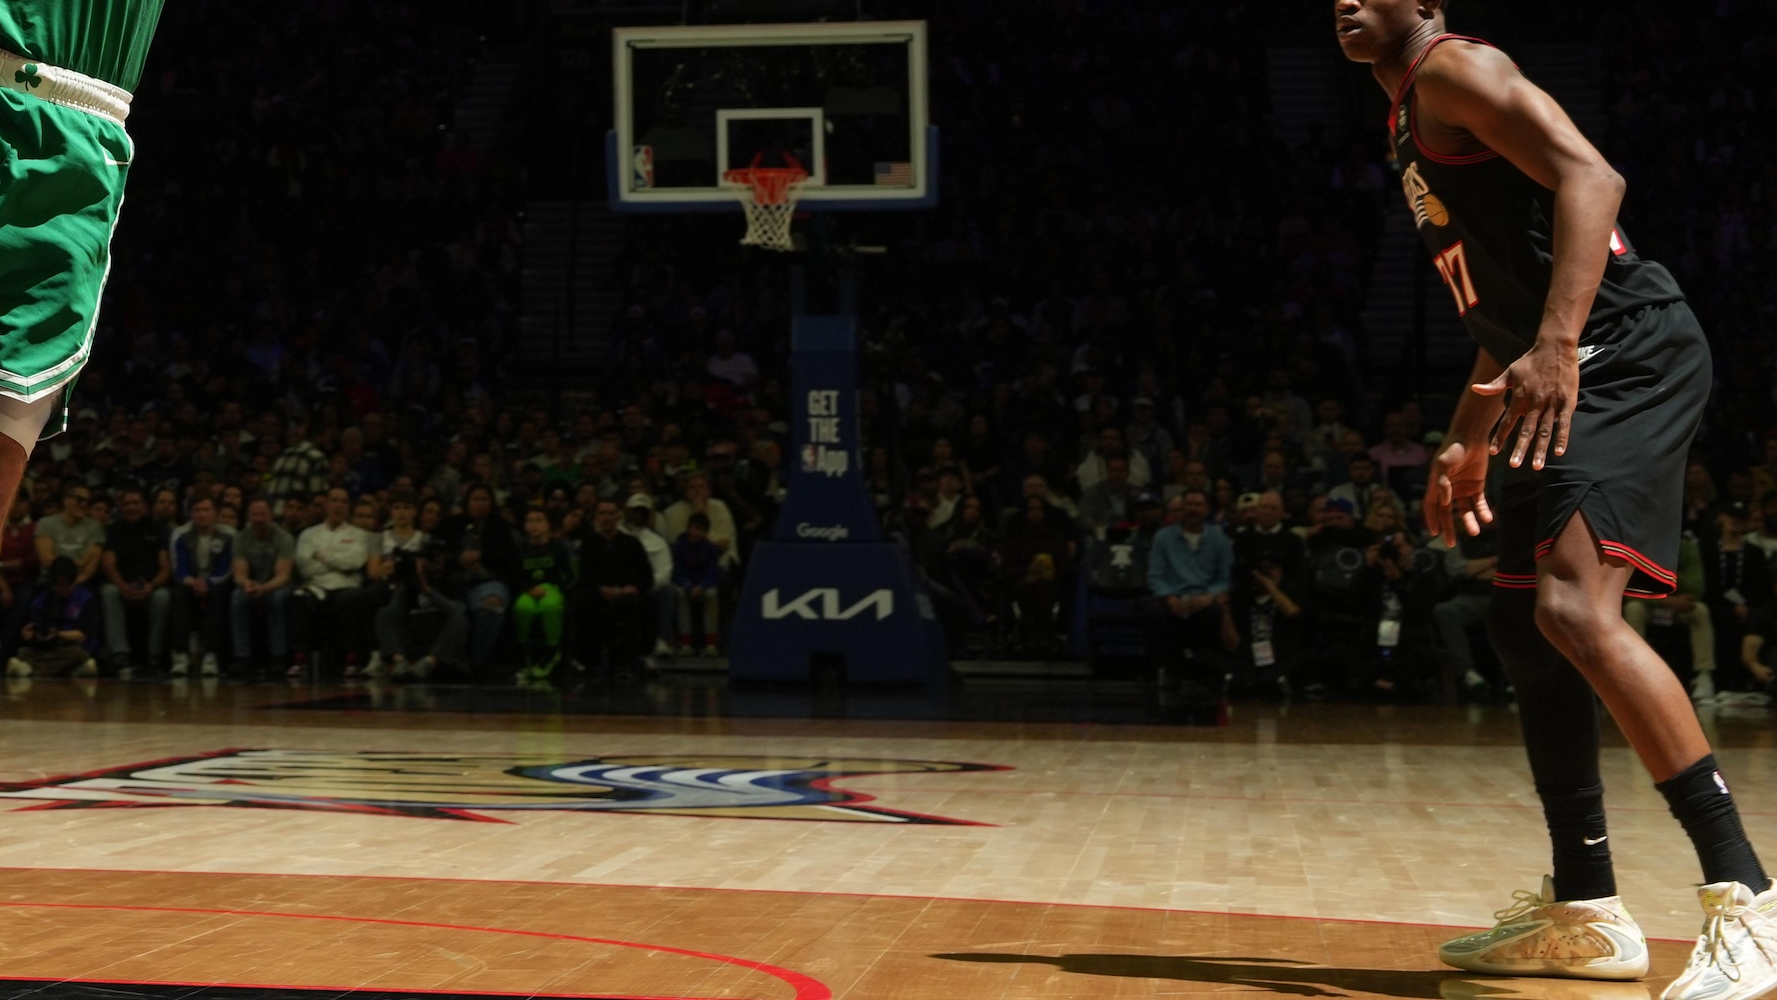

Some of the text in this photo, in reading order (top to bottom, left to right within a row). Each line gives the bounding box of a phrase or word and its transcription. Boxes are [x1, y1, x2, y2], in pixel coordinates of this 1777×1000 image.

[807, 389, 840, 416] GET
[807, 416, 842, 444] THE
[796, 522, 850, 542] Google
[761, 587, 894, 621] KIA
